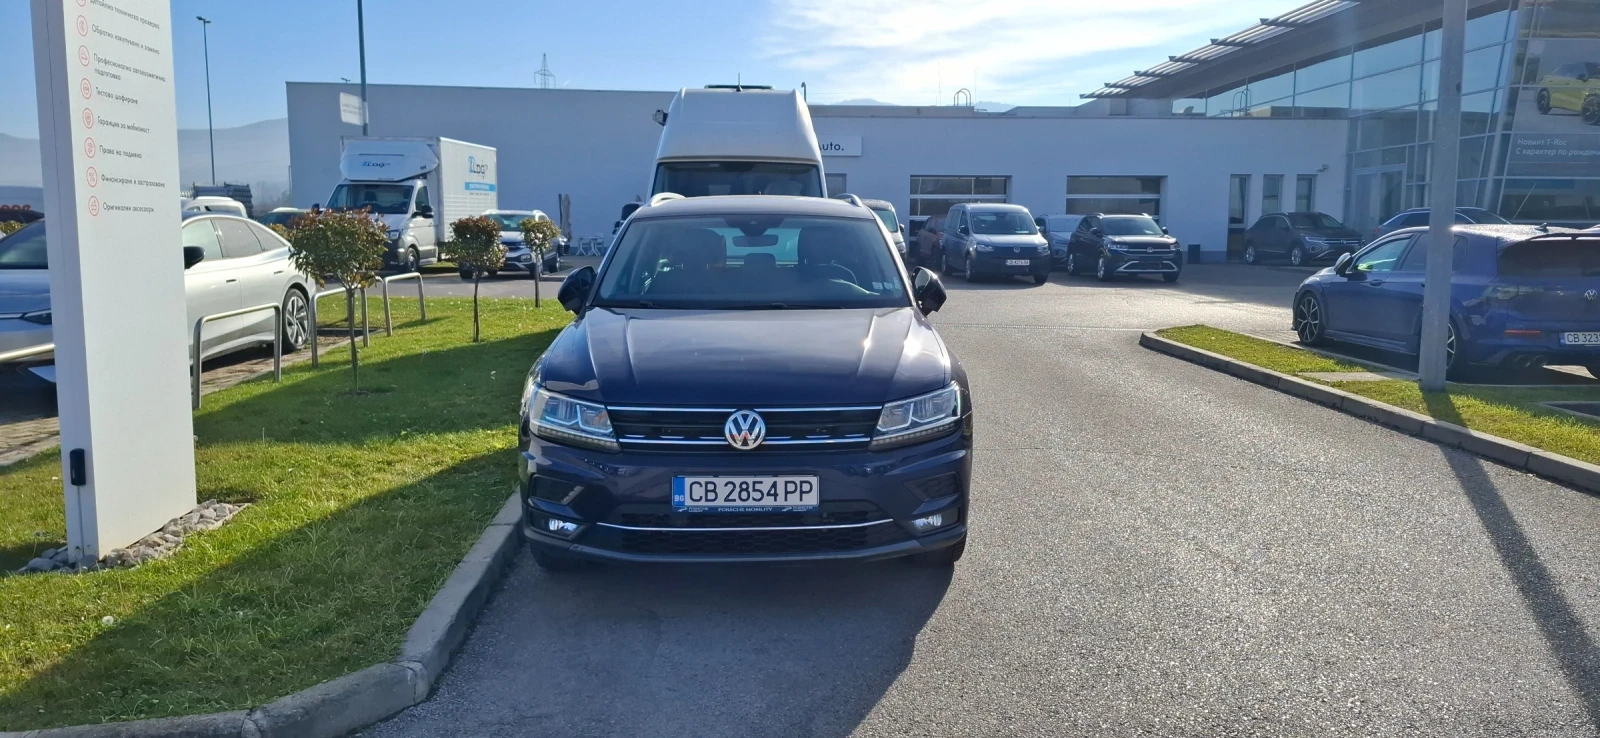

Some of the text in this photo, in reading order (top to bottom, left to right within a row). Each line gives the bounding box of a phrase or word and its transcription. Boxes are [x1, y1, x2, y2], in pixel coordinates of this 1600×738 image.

[114, 7, 139, 21] техническа
[140, 17, 160, 30] проверка
[92, 24, 114, 38] Обратно
[114, 34, 140, 48] изкупуване
[94, 53, 132, 72] Професионална
[94, 68, 121, 80] подготовка
[114, 94, 138, 105] шофиране
[98, 116, 120, 128] Гаранция
[126, 123, 150, 134] мобилност
[99, 144, 115, 156] Право
[122, 151, 142, 159] подмяна
[101, 174, 132, 186] Финансиране
[137, 180, 166, 188] застраховане
[102, 202, 154, 214] Оригинални аксесоари
[1566, 333, 1600, 343] CB 323
[725, 410, 766, 450] VW
[689, 480, 813, 502] CB 2854 PP
